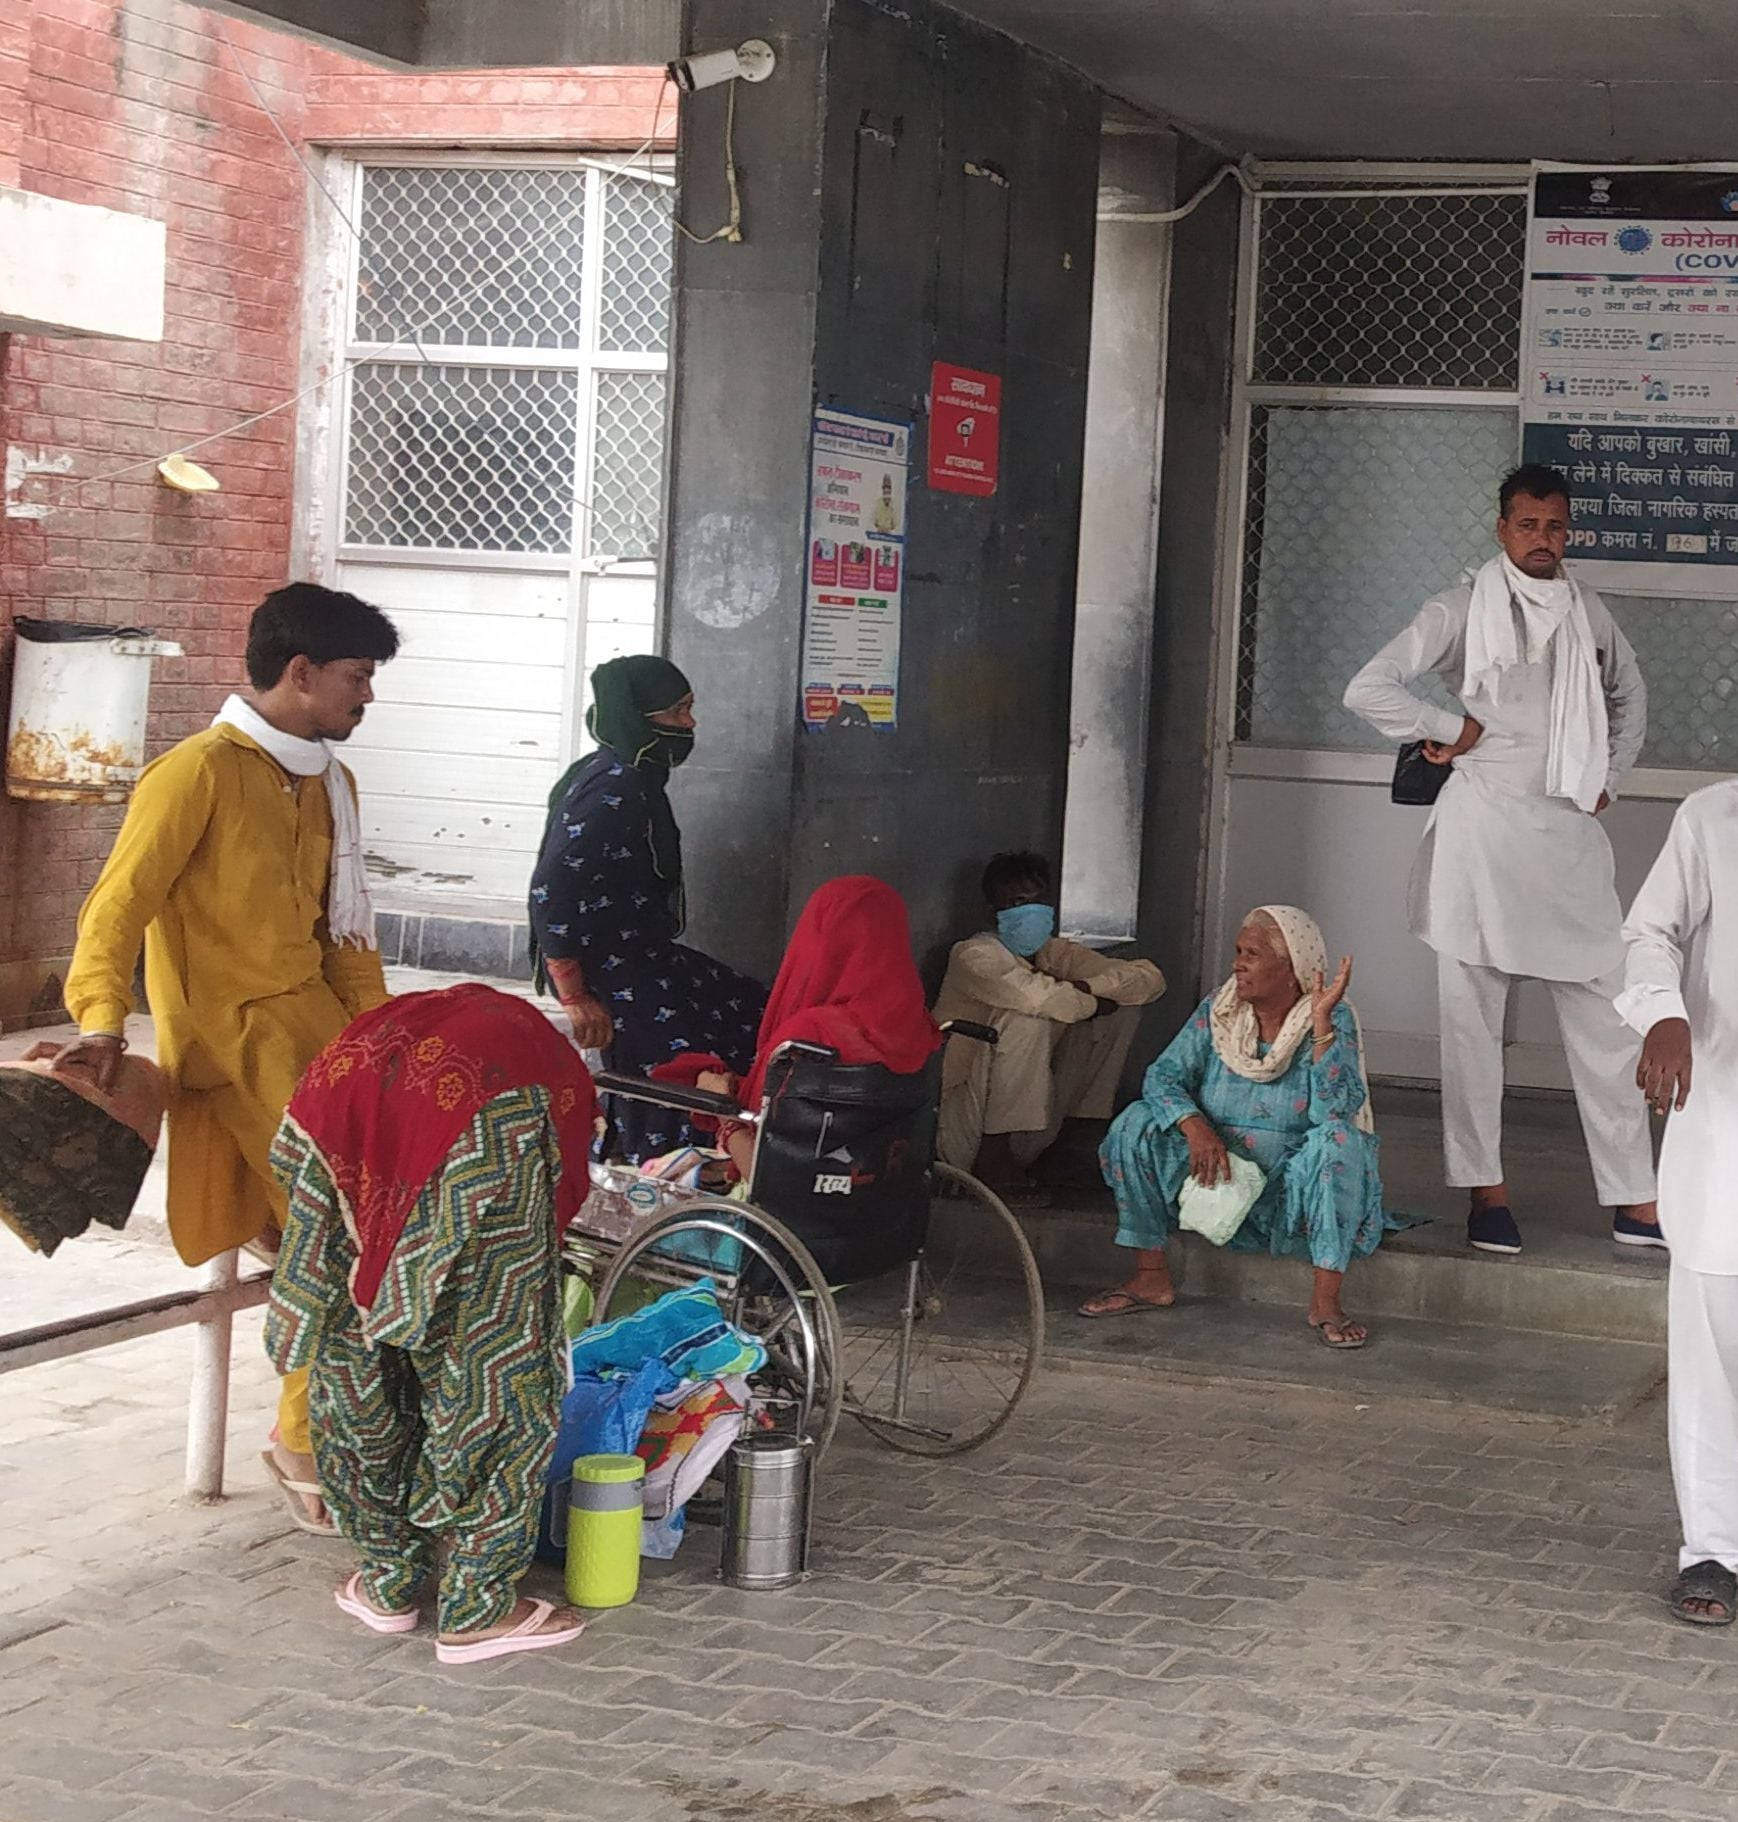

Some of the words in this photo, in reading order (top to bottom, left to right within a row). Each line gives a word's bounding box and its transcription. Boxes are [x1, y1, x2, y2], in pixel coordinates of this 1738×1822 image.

[1546, 224, 1608, 246] नोवल
[1567, 428, 1593, 450] यदि
[1598, 430, 1642, 451] आपको
[1646, 435, 1689, 459] बुखार,
[1694, 431, 1736, 458] खांसी,
[1572, 461, 1597, 483] लेने
[1600, 461, 1611, 484] में
[1615, 461, 1664, 485] दिक्कत
[1667, 464, 1682, 486] से
[1686, 465, 1735, 487] संबंधित
[1608, 493, 1642, 517] जिला
[1646, 496, 1699, 518] नागरिक
[1601, 531, 1637, 548] कमरा
[1641, 529, 1658, 549] नं.
[1709, 529, 1721, 551] में
